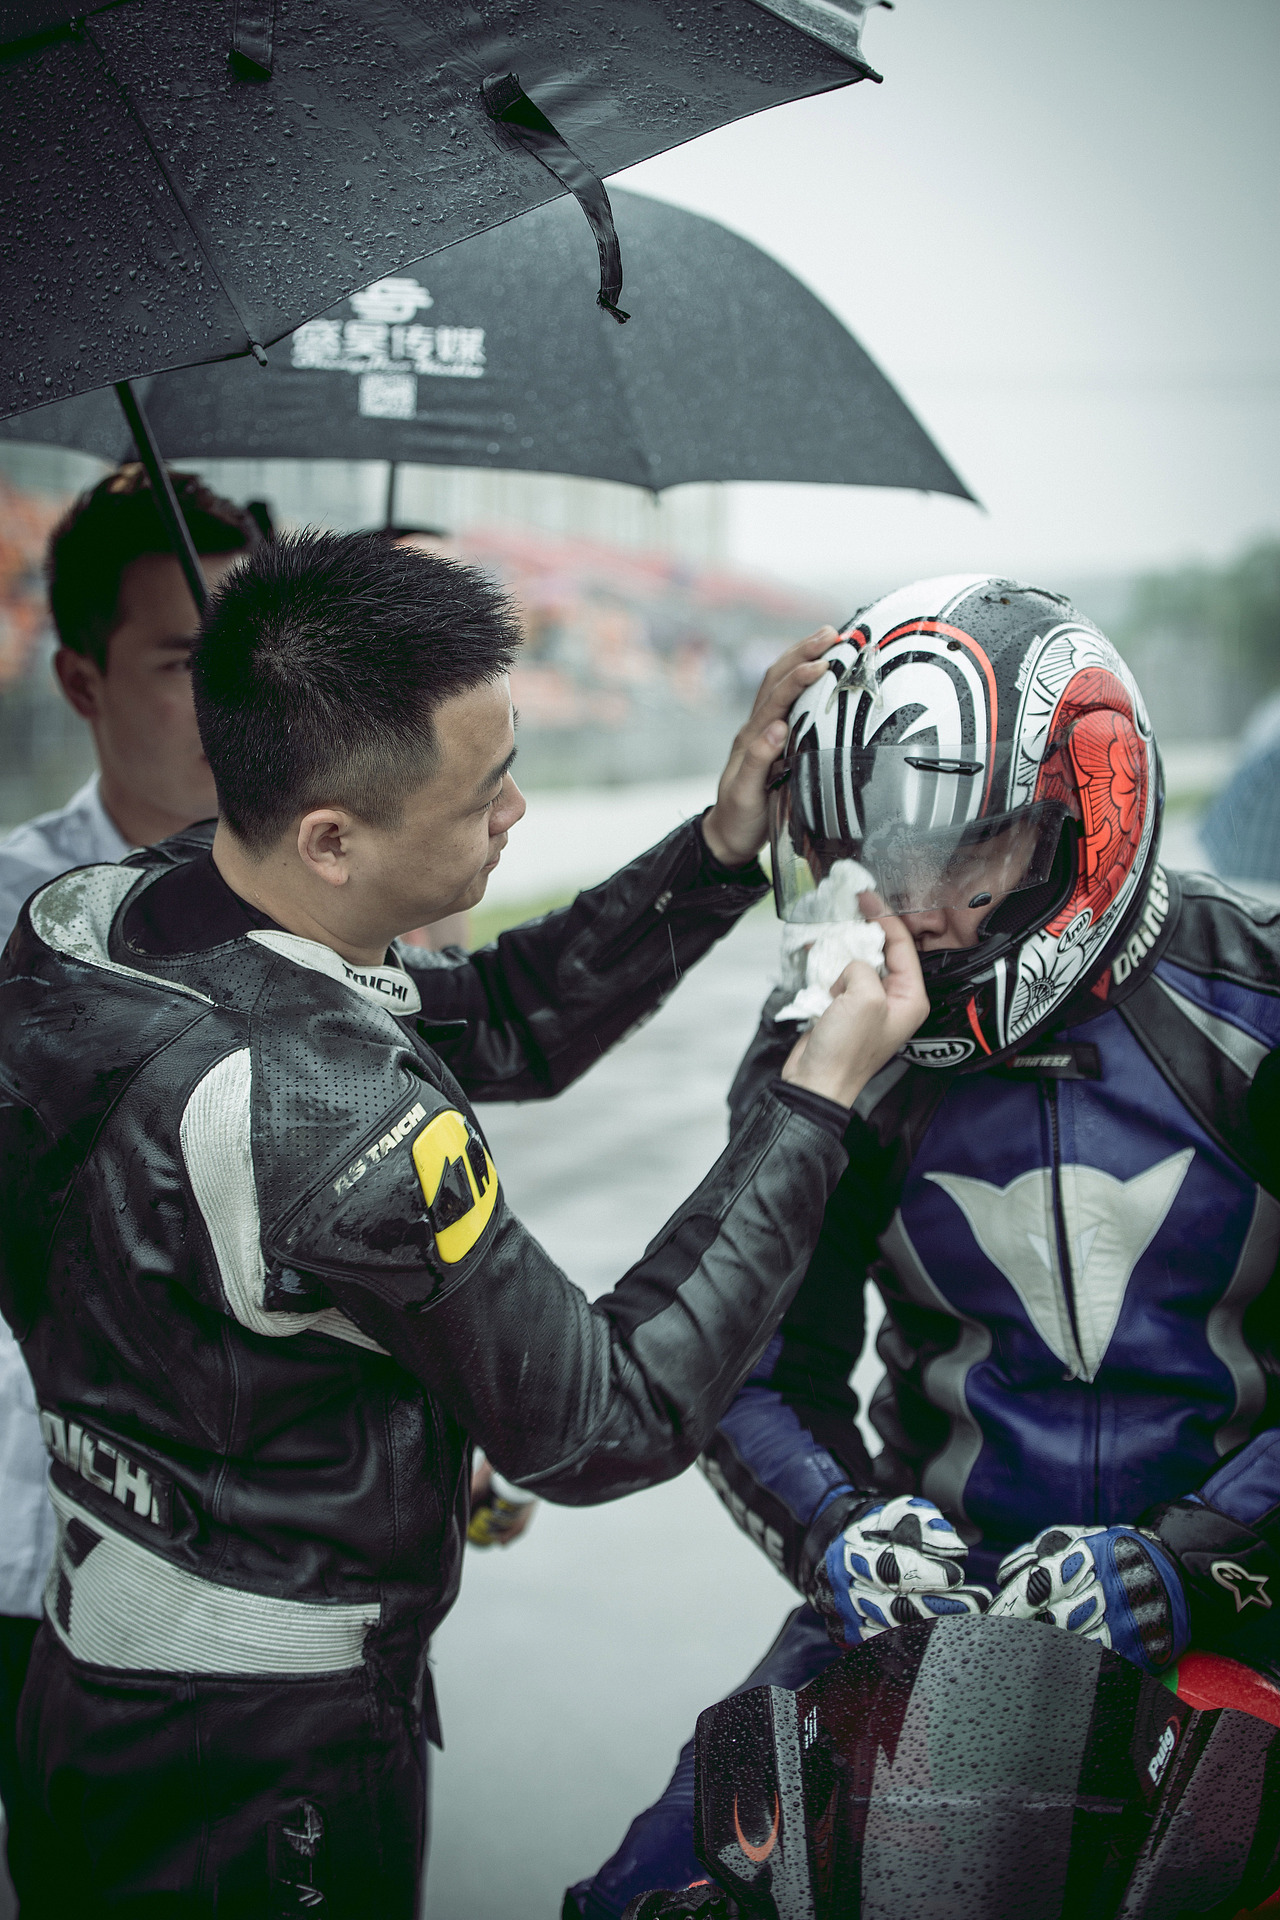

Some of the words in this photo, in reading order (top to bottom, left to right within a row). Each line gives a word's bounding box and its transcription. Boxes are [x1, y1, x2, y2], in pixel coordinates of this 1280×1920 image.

[1065, 912, 1088, 944] Arai
[342, 963, 409, 1003] TAICHI
[898, 1041, 960, 1059] Arai
[365, 1102, 427, 1165] TAICHI
[1148, 1725, 1175, 1782] Puig
